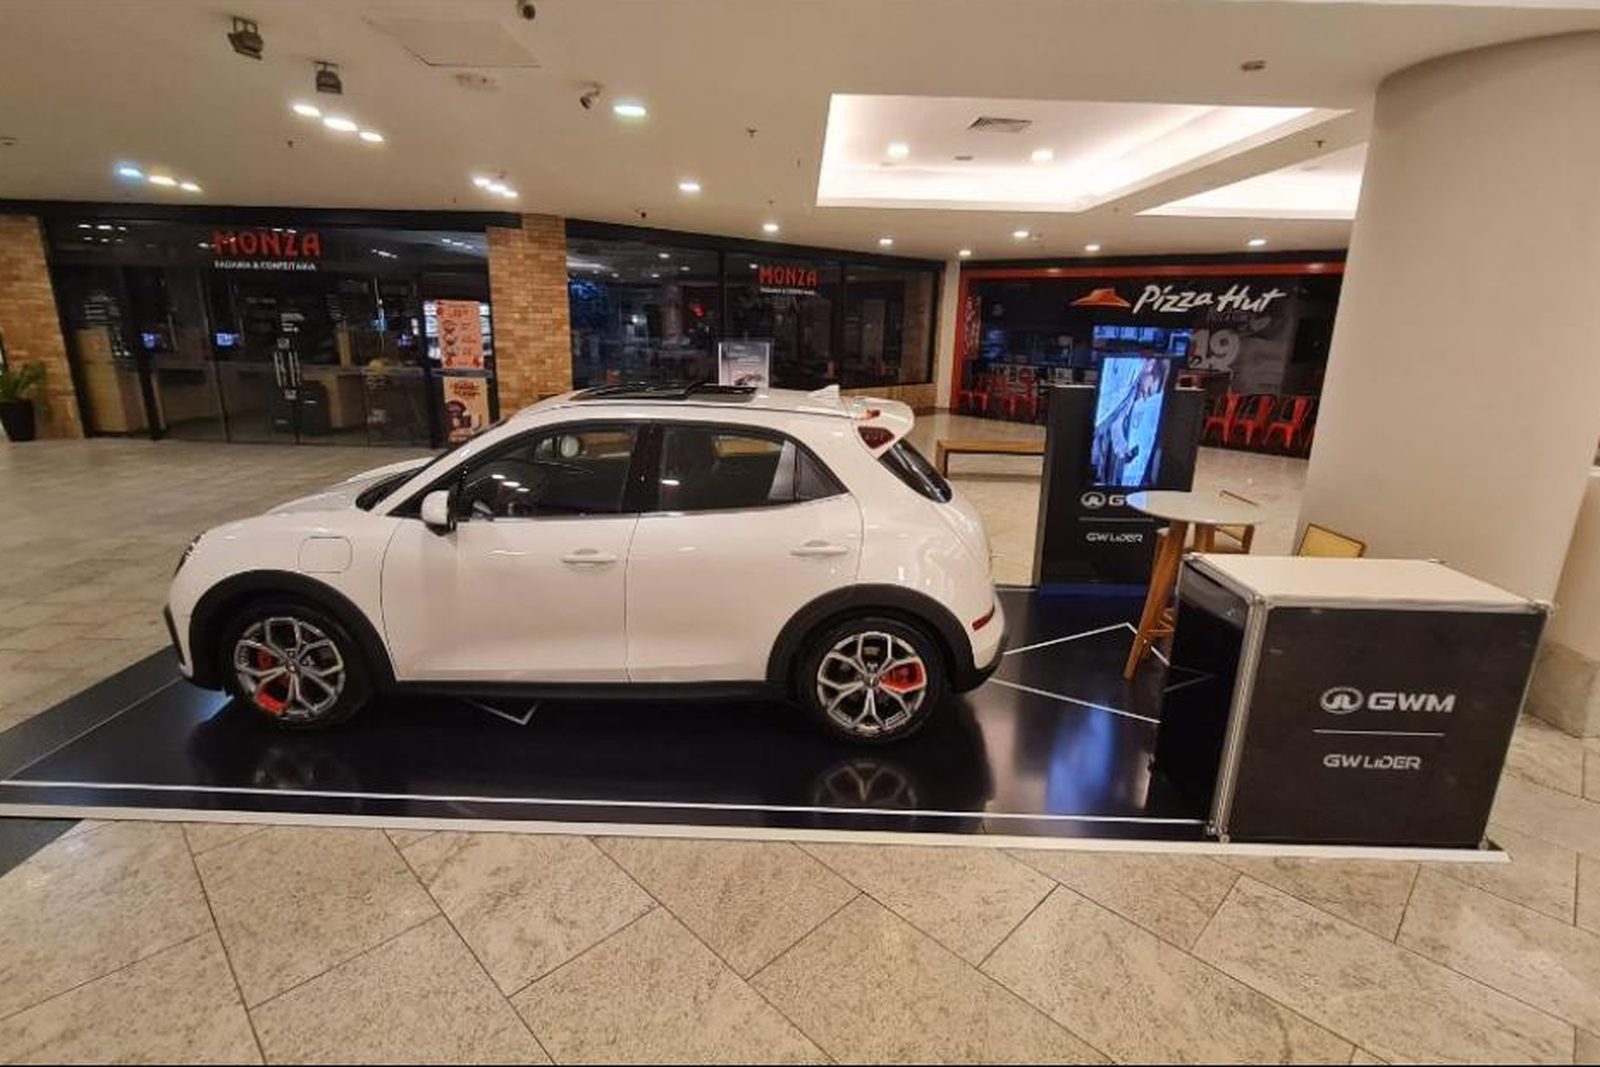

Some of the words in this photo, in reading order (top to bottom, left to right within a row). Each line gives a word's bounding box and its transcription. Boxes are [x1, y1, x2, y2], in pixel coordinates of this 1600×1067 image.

[212, 229, 321, 258] MONZA
[760, 265, 817, 286] MONZA
[1132, 283, 1214, 314] Pizza
[1215, 282, 1288, 313] Hut
[1368, 691, 1456, 713] GWM
[1322, 753, 1363, 768] GW
